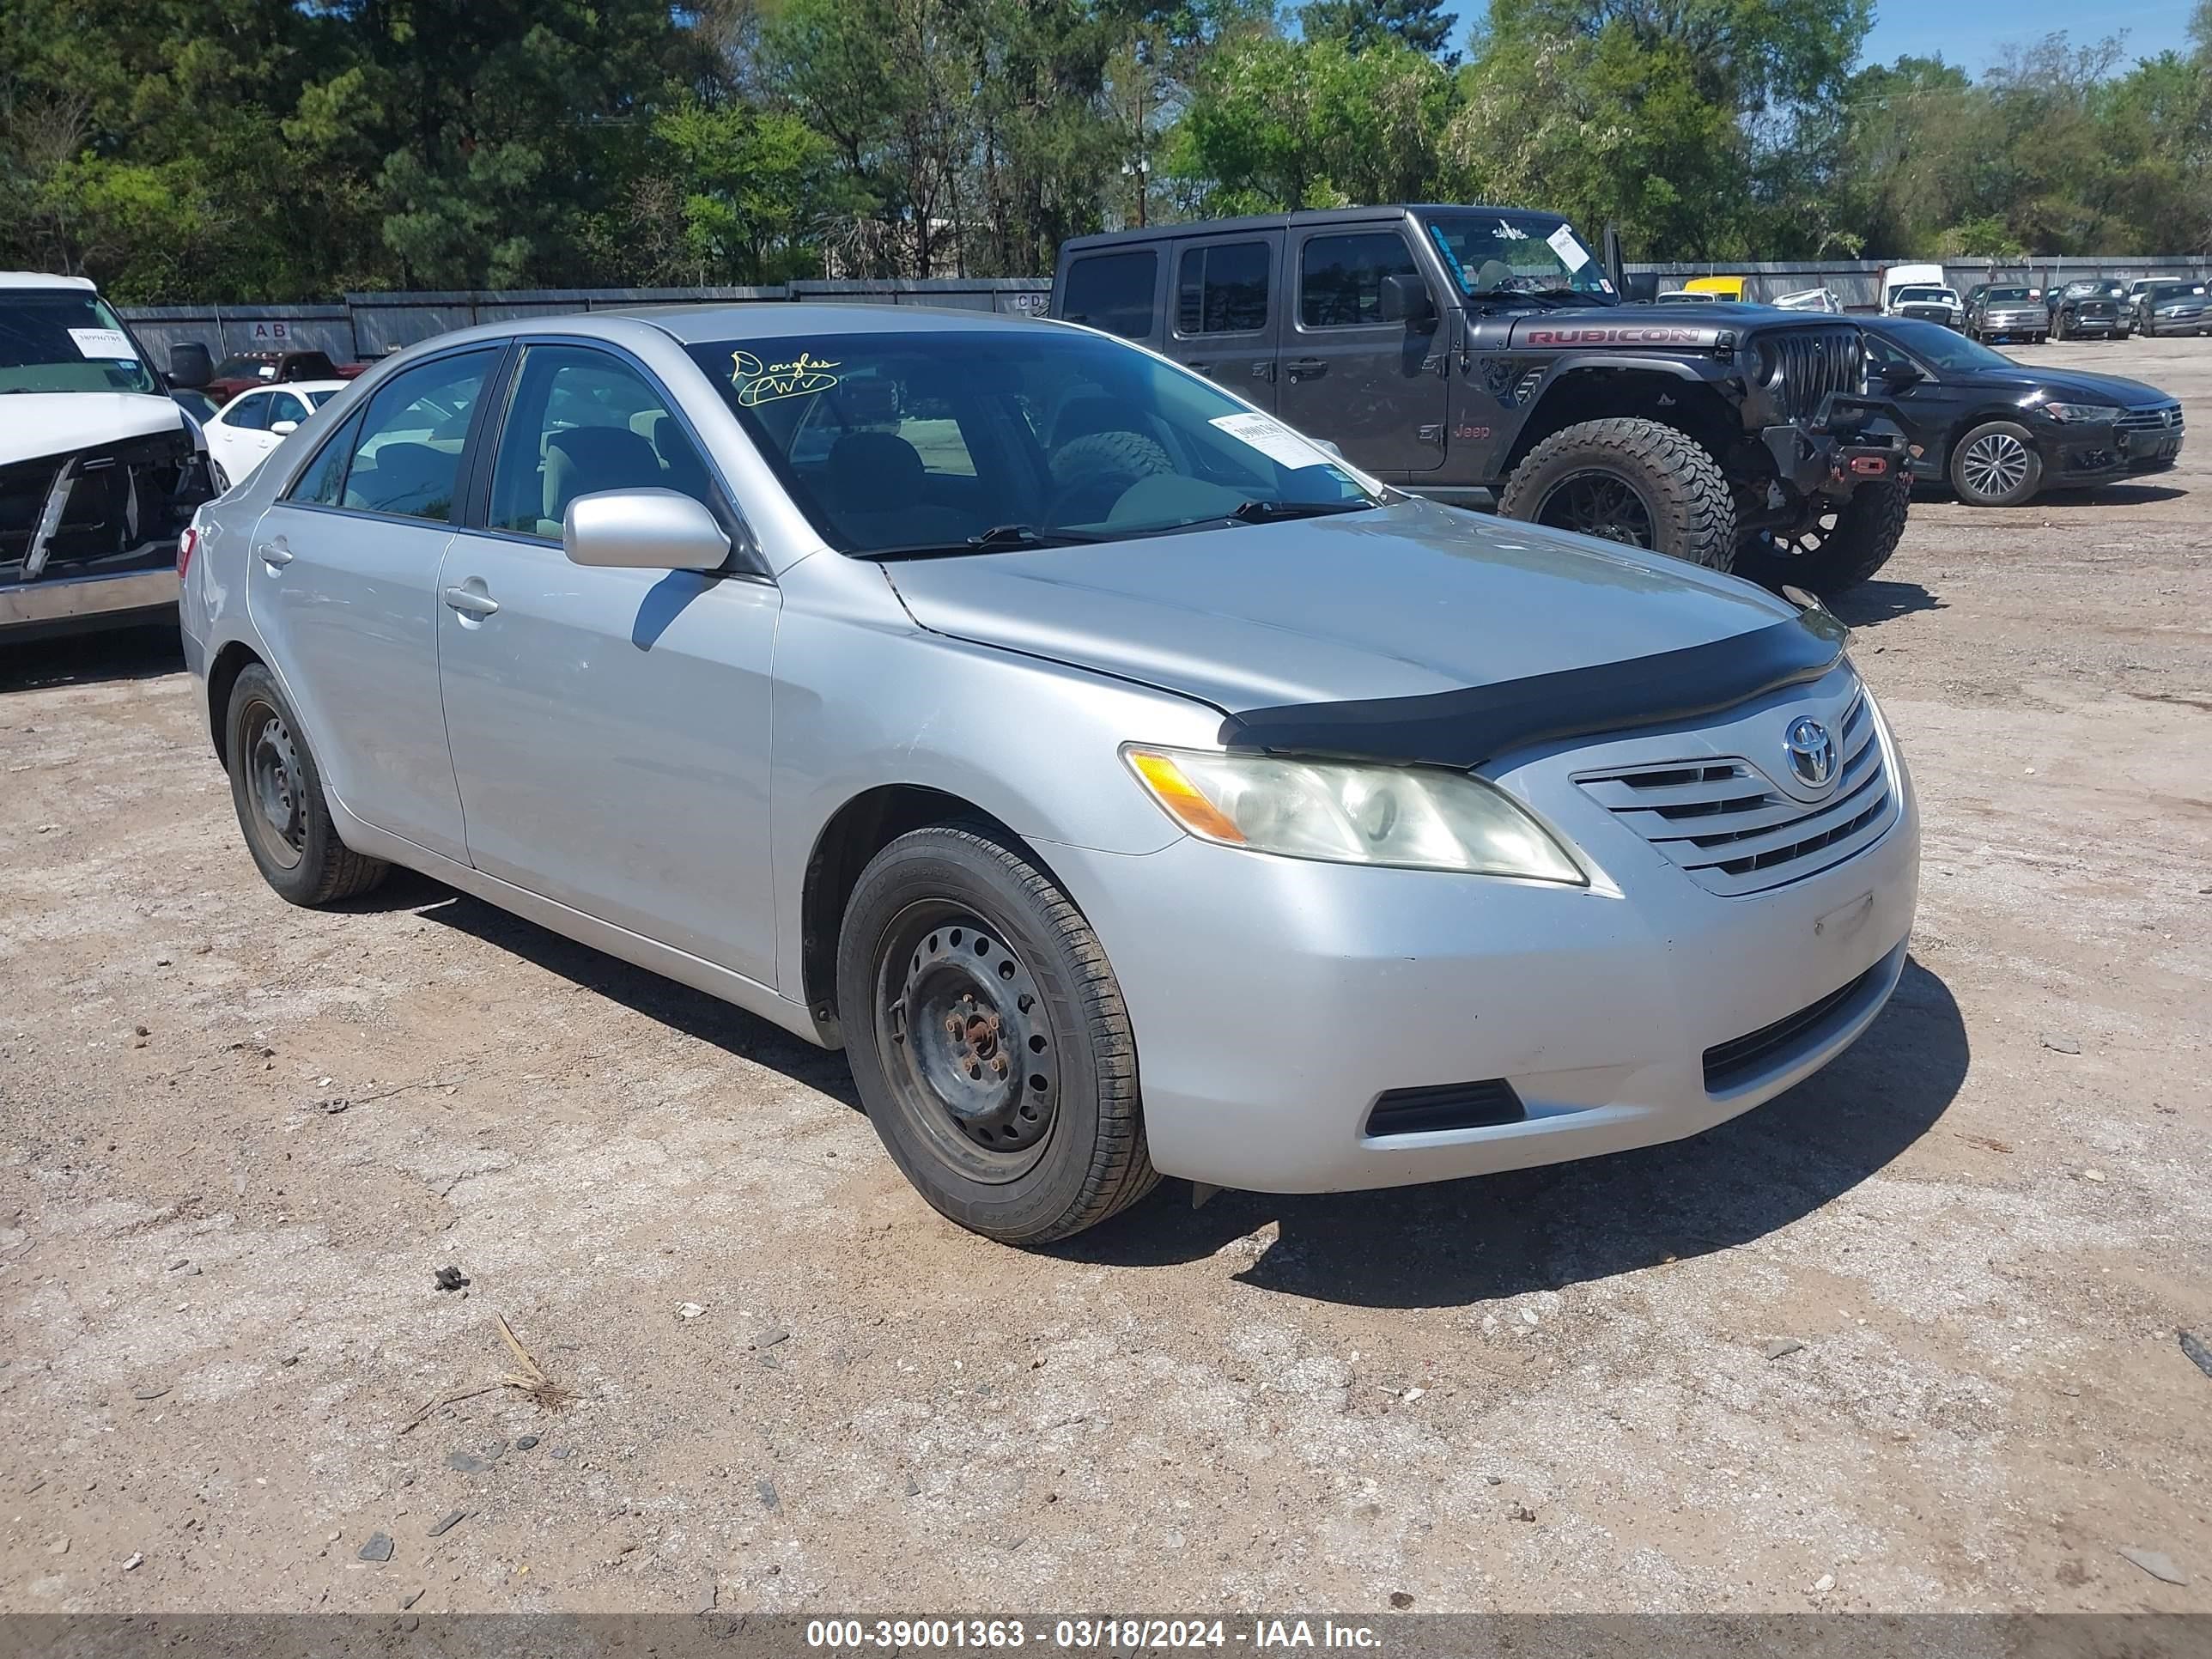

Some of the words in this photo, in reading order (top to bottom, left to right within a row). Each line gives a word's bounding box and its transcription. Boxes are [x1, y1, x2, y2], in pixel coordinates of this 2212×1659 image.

[1018, 295, 1028, 307] C
[1031, 295, 1041, 307] D
[255, 323, 269, 337] A
[273, 323, 286, 337] B
[1528, 329, 1701, 344] RUBICON
[730, 350, 842, 382] Douglas
[1454, 423, 1491, 440] Jeep
